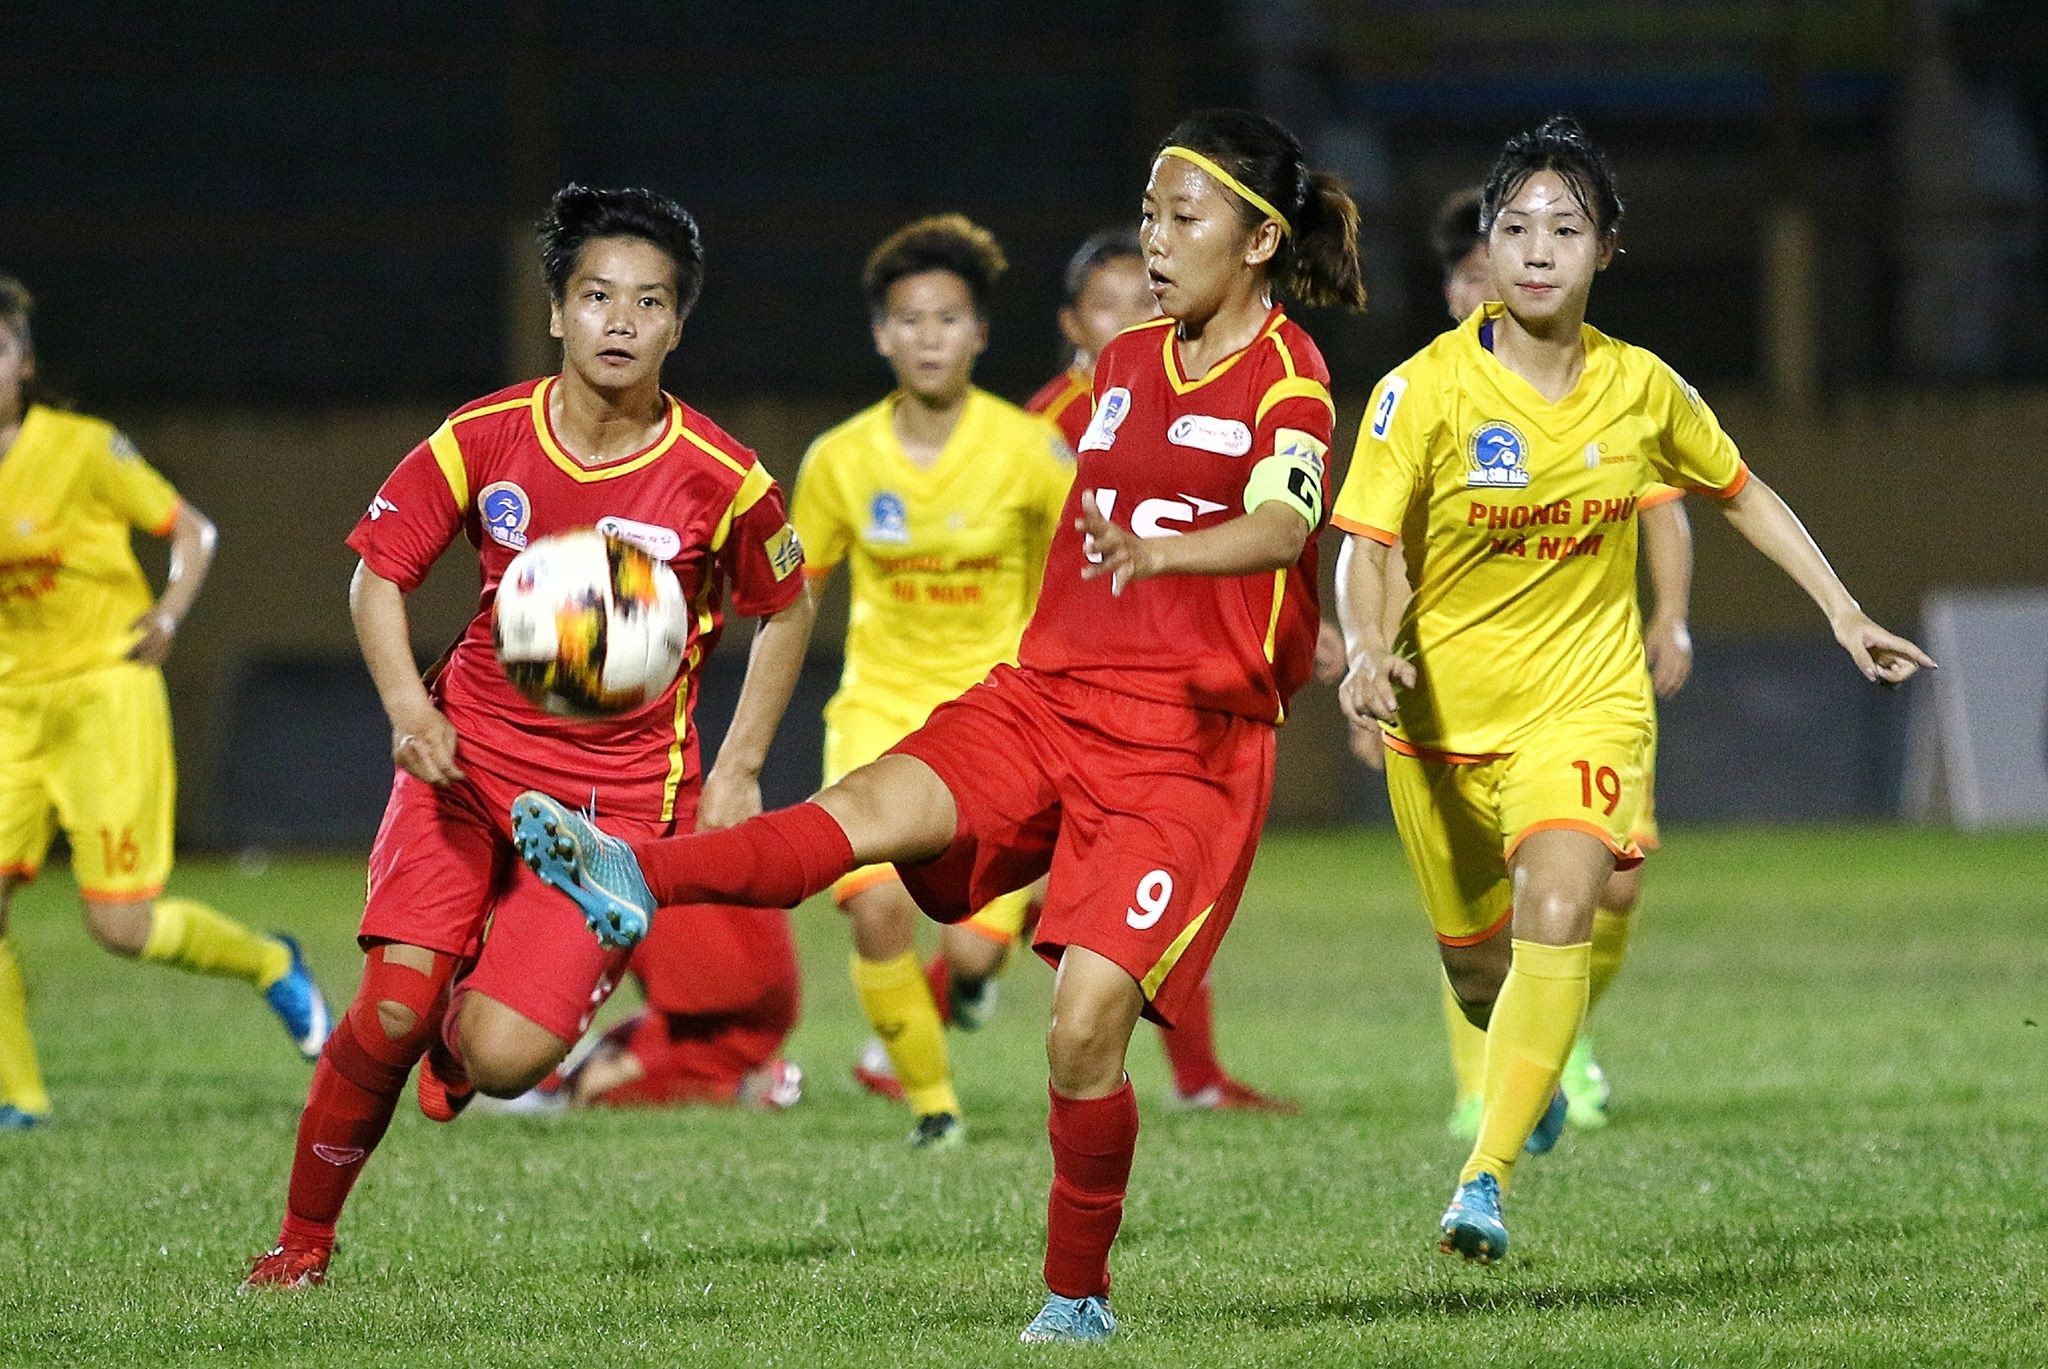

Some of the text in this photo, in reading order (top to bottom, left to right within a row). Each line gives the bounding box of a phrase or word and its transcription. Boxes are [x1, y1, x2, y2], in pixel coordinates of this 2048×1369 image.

[1467, 499, 1572, 530] PHONG
[1537, 535, 1604, 560] NAM
[1571, 760, 1621, 817] 19
[98, 825, 139, 877] 16
[1126, 868, 1174, 930] 9
